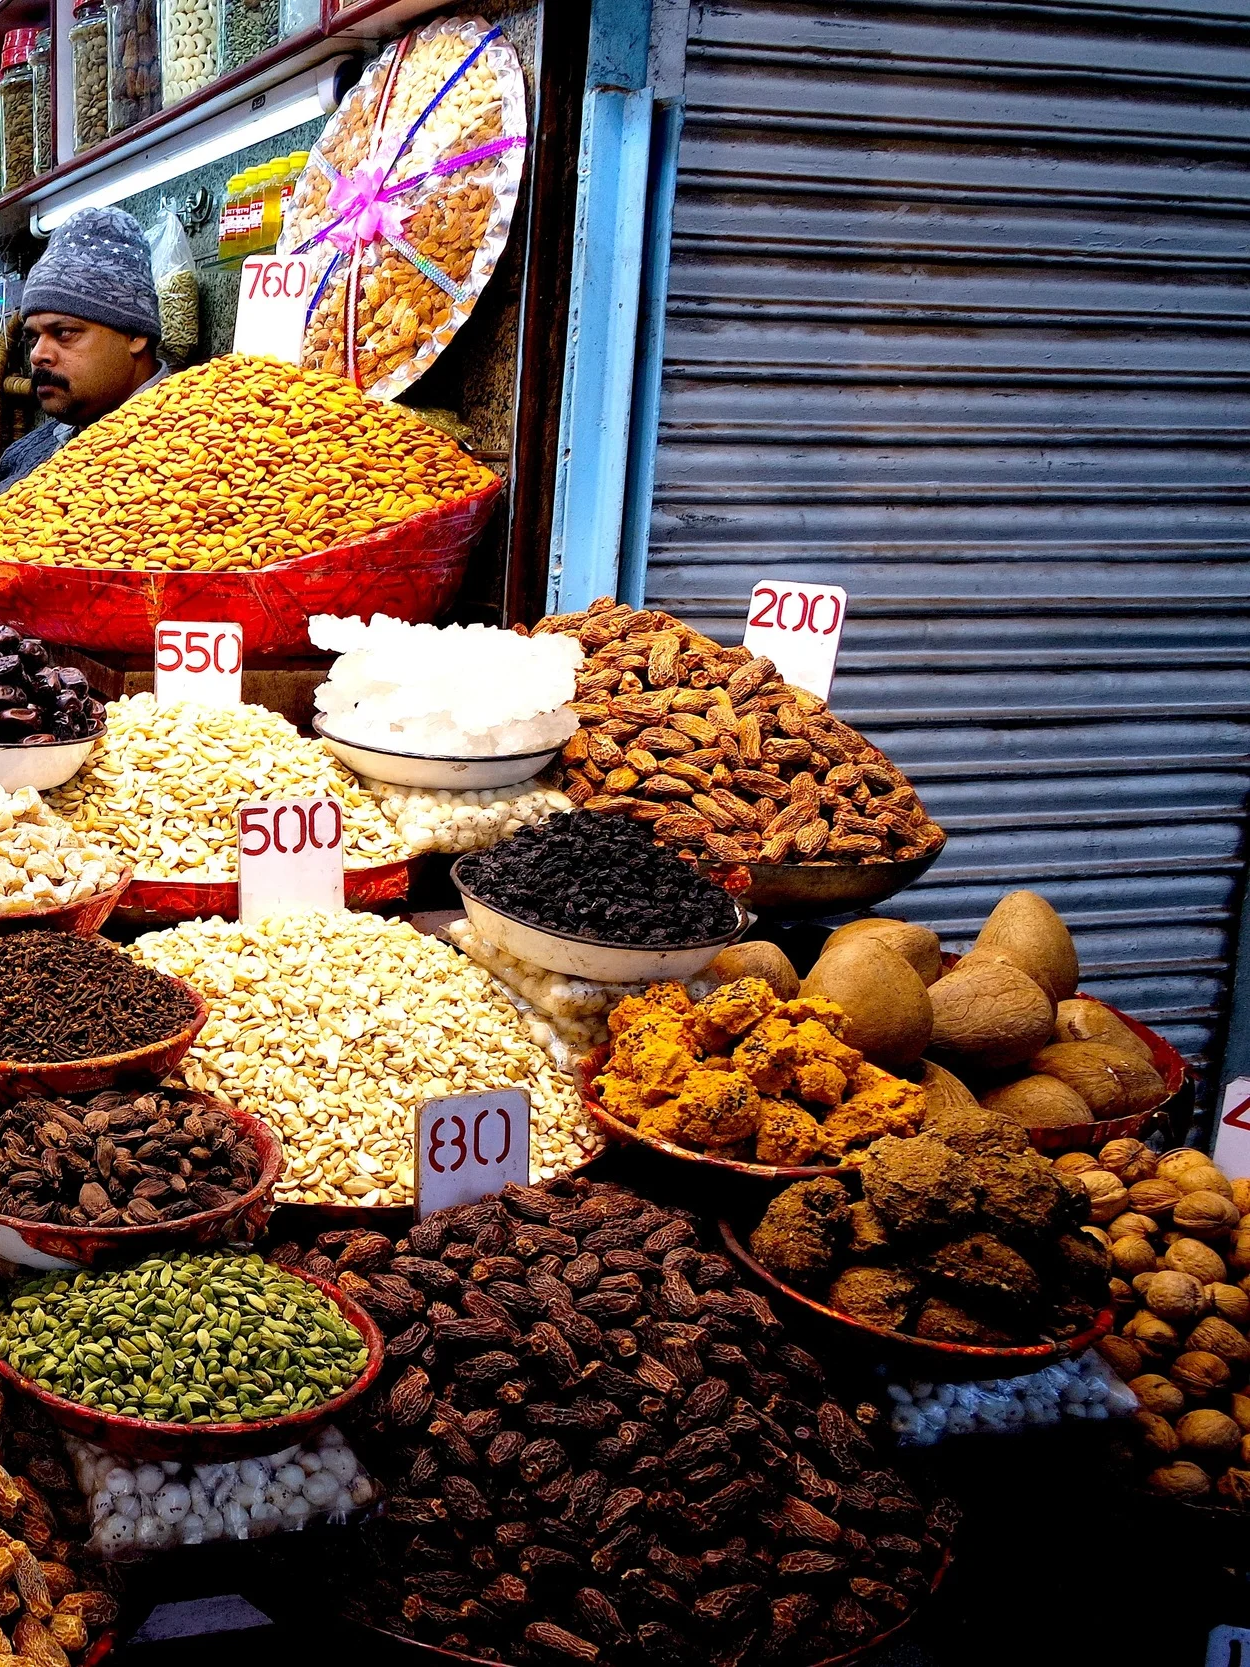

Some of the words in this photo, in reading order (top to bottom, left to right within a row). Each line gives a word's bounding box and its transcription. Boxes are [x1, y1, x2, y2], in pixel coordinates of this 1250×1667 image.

[244, 262, 306, 300] 760
[749, 587, 841, 636] 200
[157, 630, 241, 674] 550
[240, 800, 342, 857] 500
[428, 1109, 511, 1173] 80
